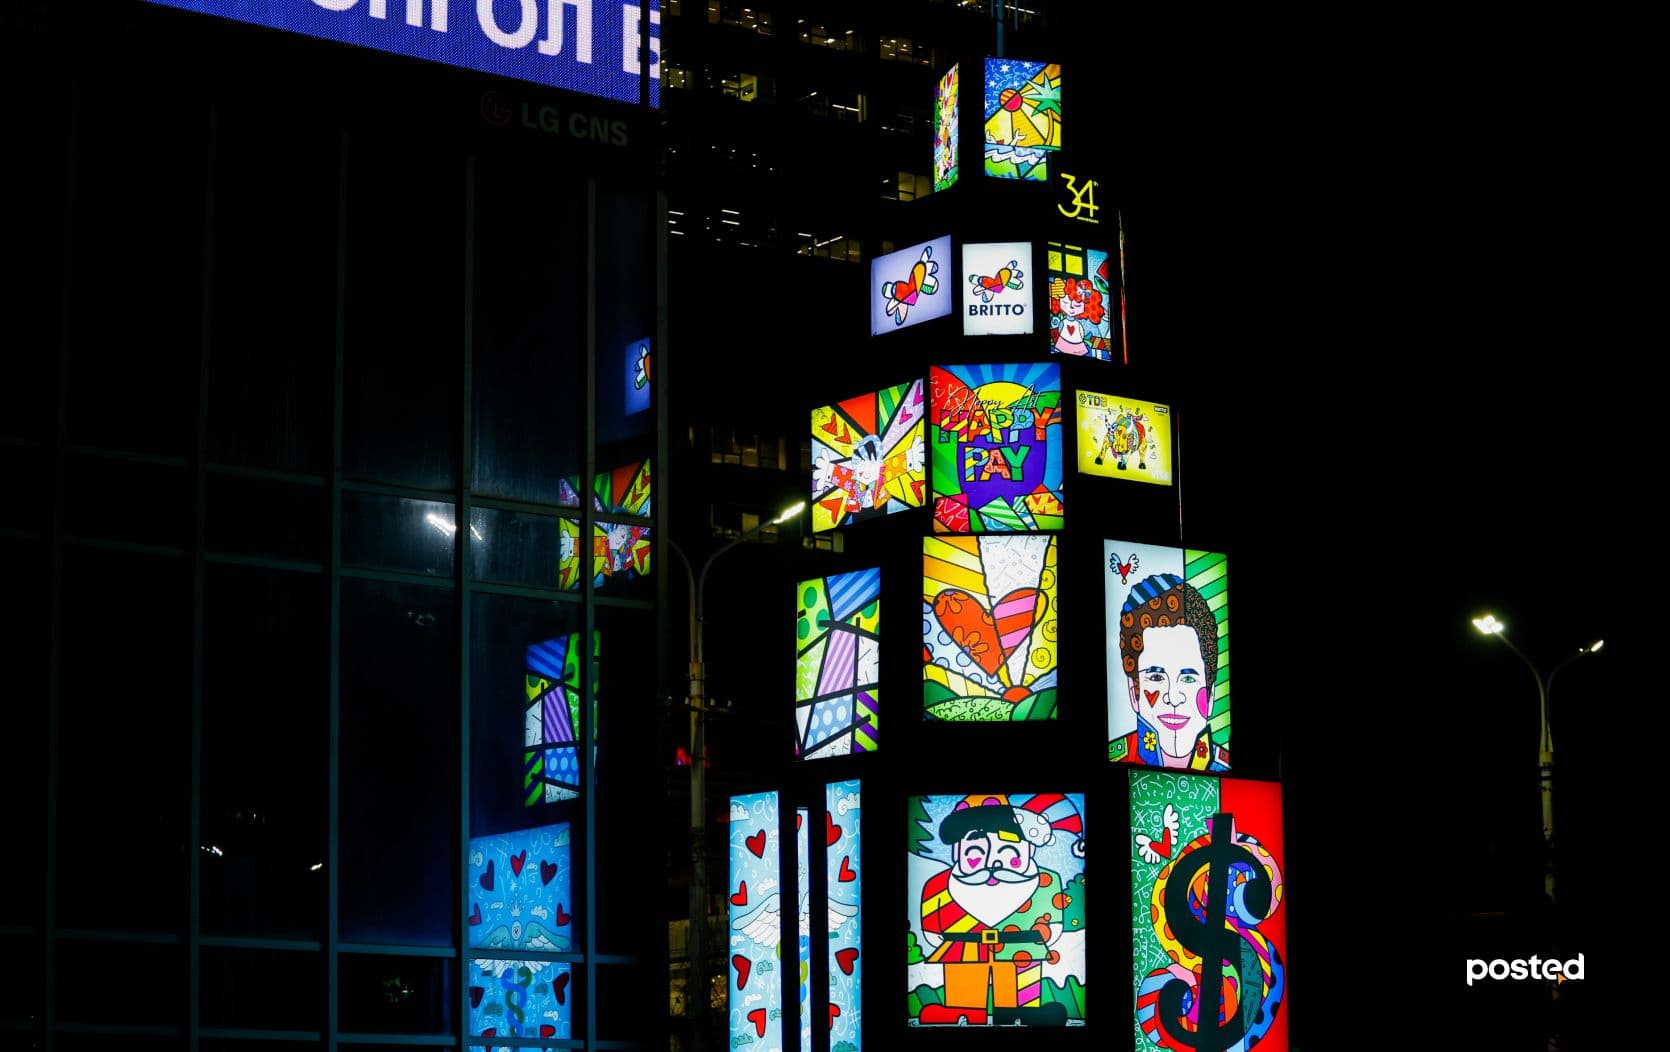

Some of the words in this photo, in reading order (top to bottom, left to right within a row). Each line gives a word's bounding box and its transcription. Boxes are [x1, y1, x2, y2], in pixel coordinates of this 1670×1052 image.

[519, 101, 561, 135] LG
[567, 112, 630, 147] CNS
[939, 406, 1055, 444] HAPPY
[963, 445, 1034, 482] PAY
